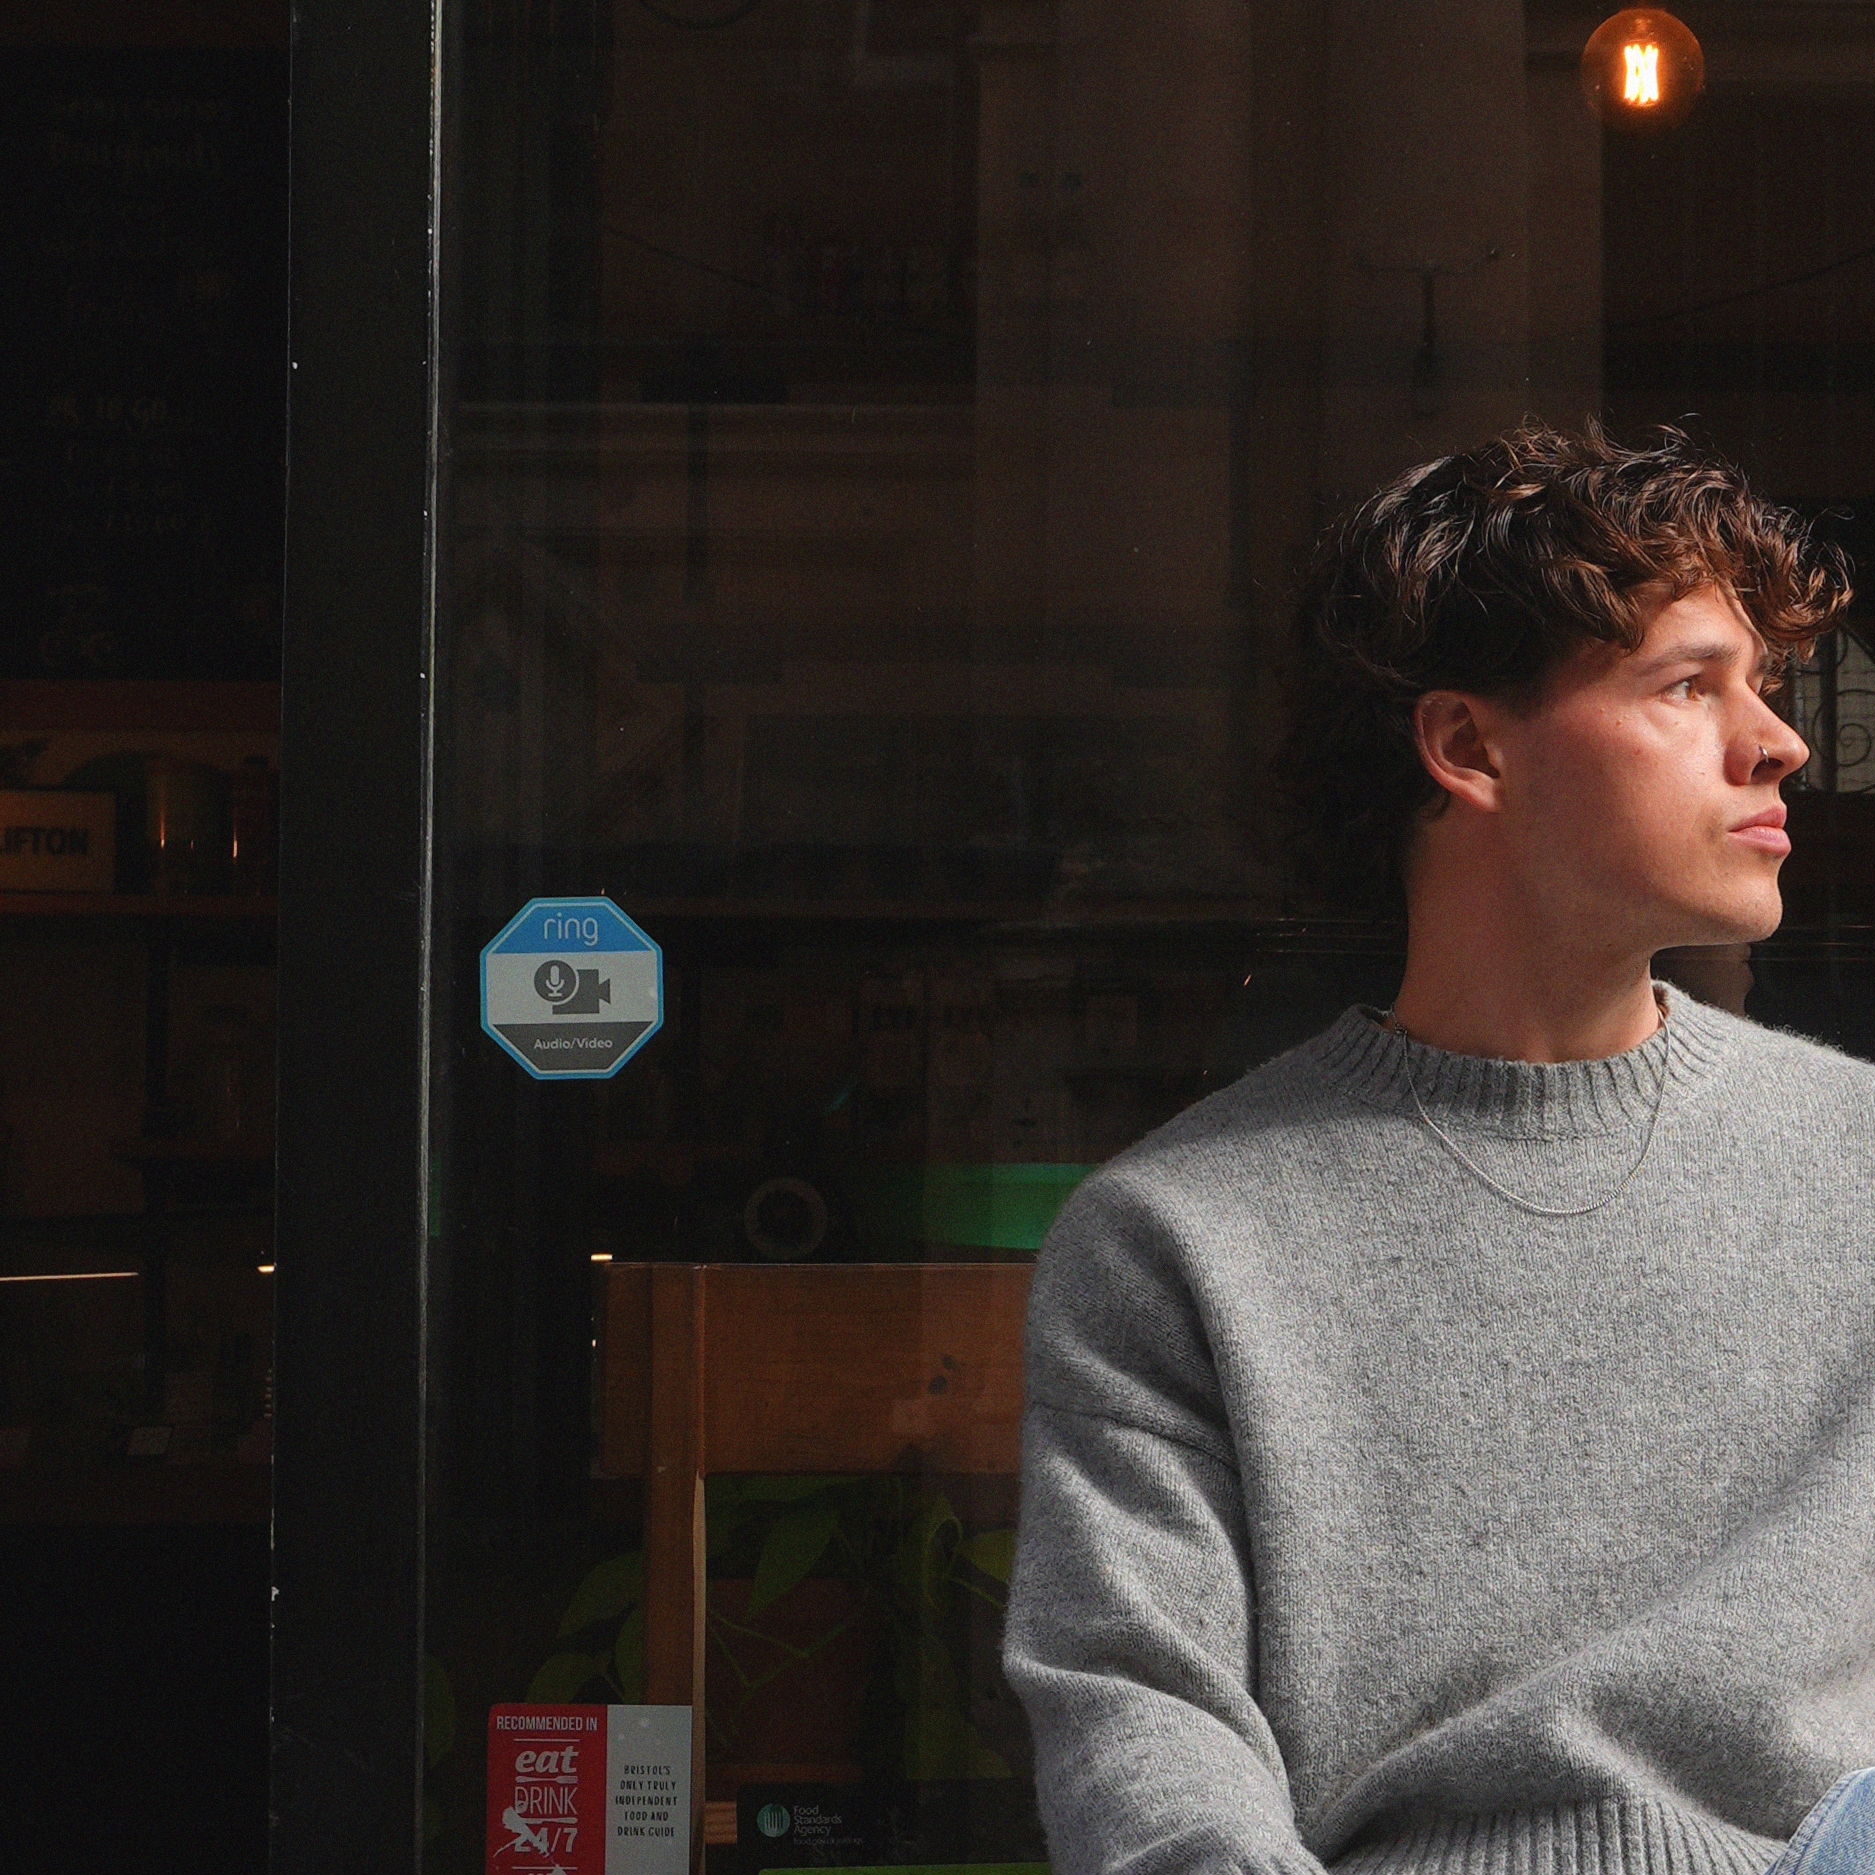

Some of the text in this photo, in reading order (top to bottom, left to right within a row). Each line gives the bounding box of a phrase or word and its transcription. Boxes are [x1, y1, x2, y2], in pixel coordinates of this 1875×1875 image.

[0, 826, 89, 855] IFTON
[543, 912, 599, 947] ring
[533, 1037, 613, 1050] Audio/Video
[496, 1715, 598, 1731] RECOMMENDED IN
[514, 1745, 579, 1774] eat
[624, 1765, 671, 1775] BRISTOL'S
[620, 1780, 676, 1791] ONLY TRULY
[514, 1786, 579, 1815] DRINK
[615, 1795, 678, 1806] INDEPENDENT
[793, 1805, 819, 1815] Food
[624, 1811, 669, 1821] FOOD AND
[793, 1814, 843, 1825] Standards
[617, 1826, 675, 1837] DRINK GUIDE
[793, 1825, 832, 1837] Agency
